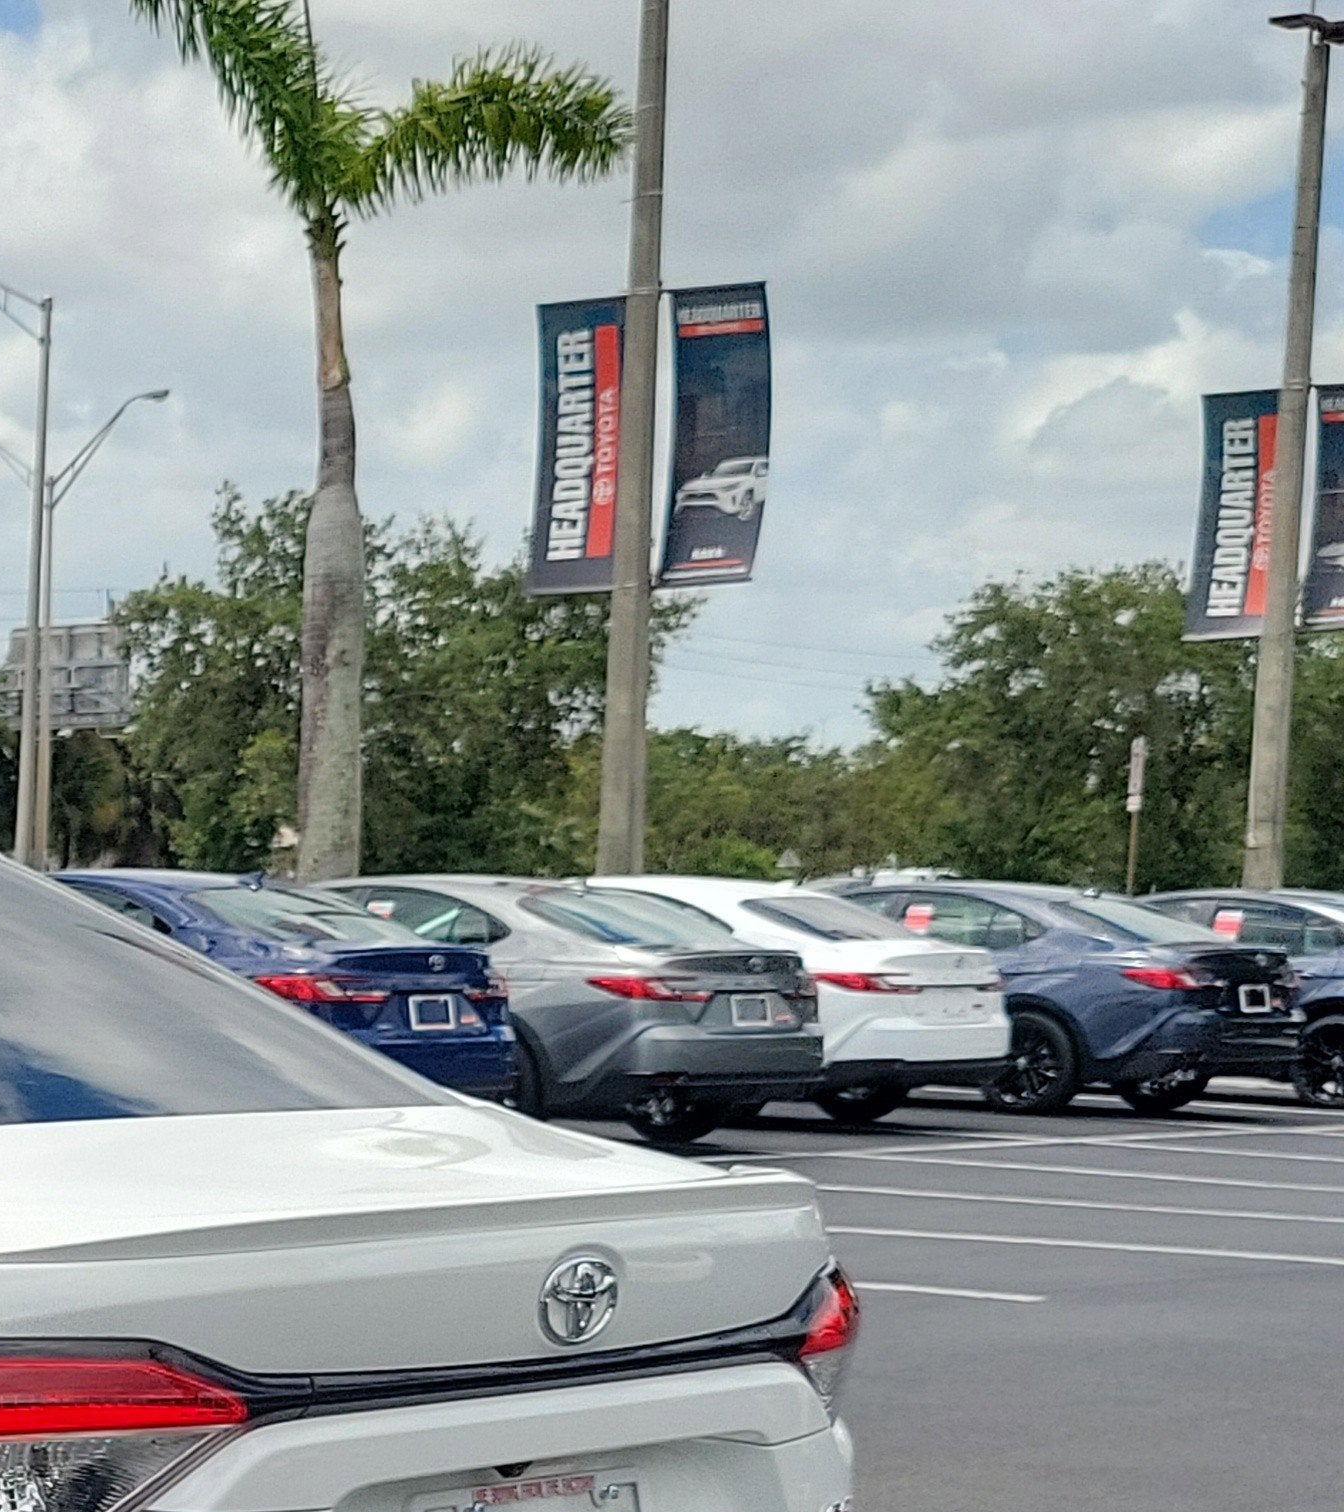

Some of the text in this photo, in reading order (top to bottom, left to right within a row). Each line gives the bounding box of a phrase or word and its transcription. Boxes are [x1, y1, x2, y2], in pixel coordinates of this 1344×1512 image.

[546, 329, 594, 560] HEADQUARTER
[595, 386, 617, 474] TOYOTA
[1205, 417, 1255, 616] HEADQUARTER
